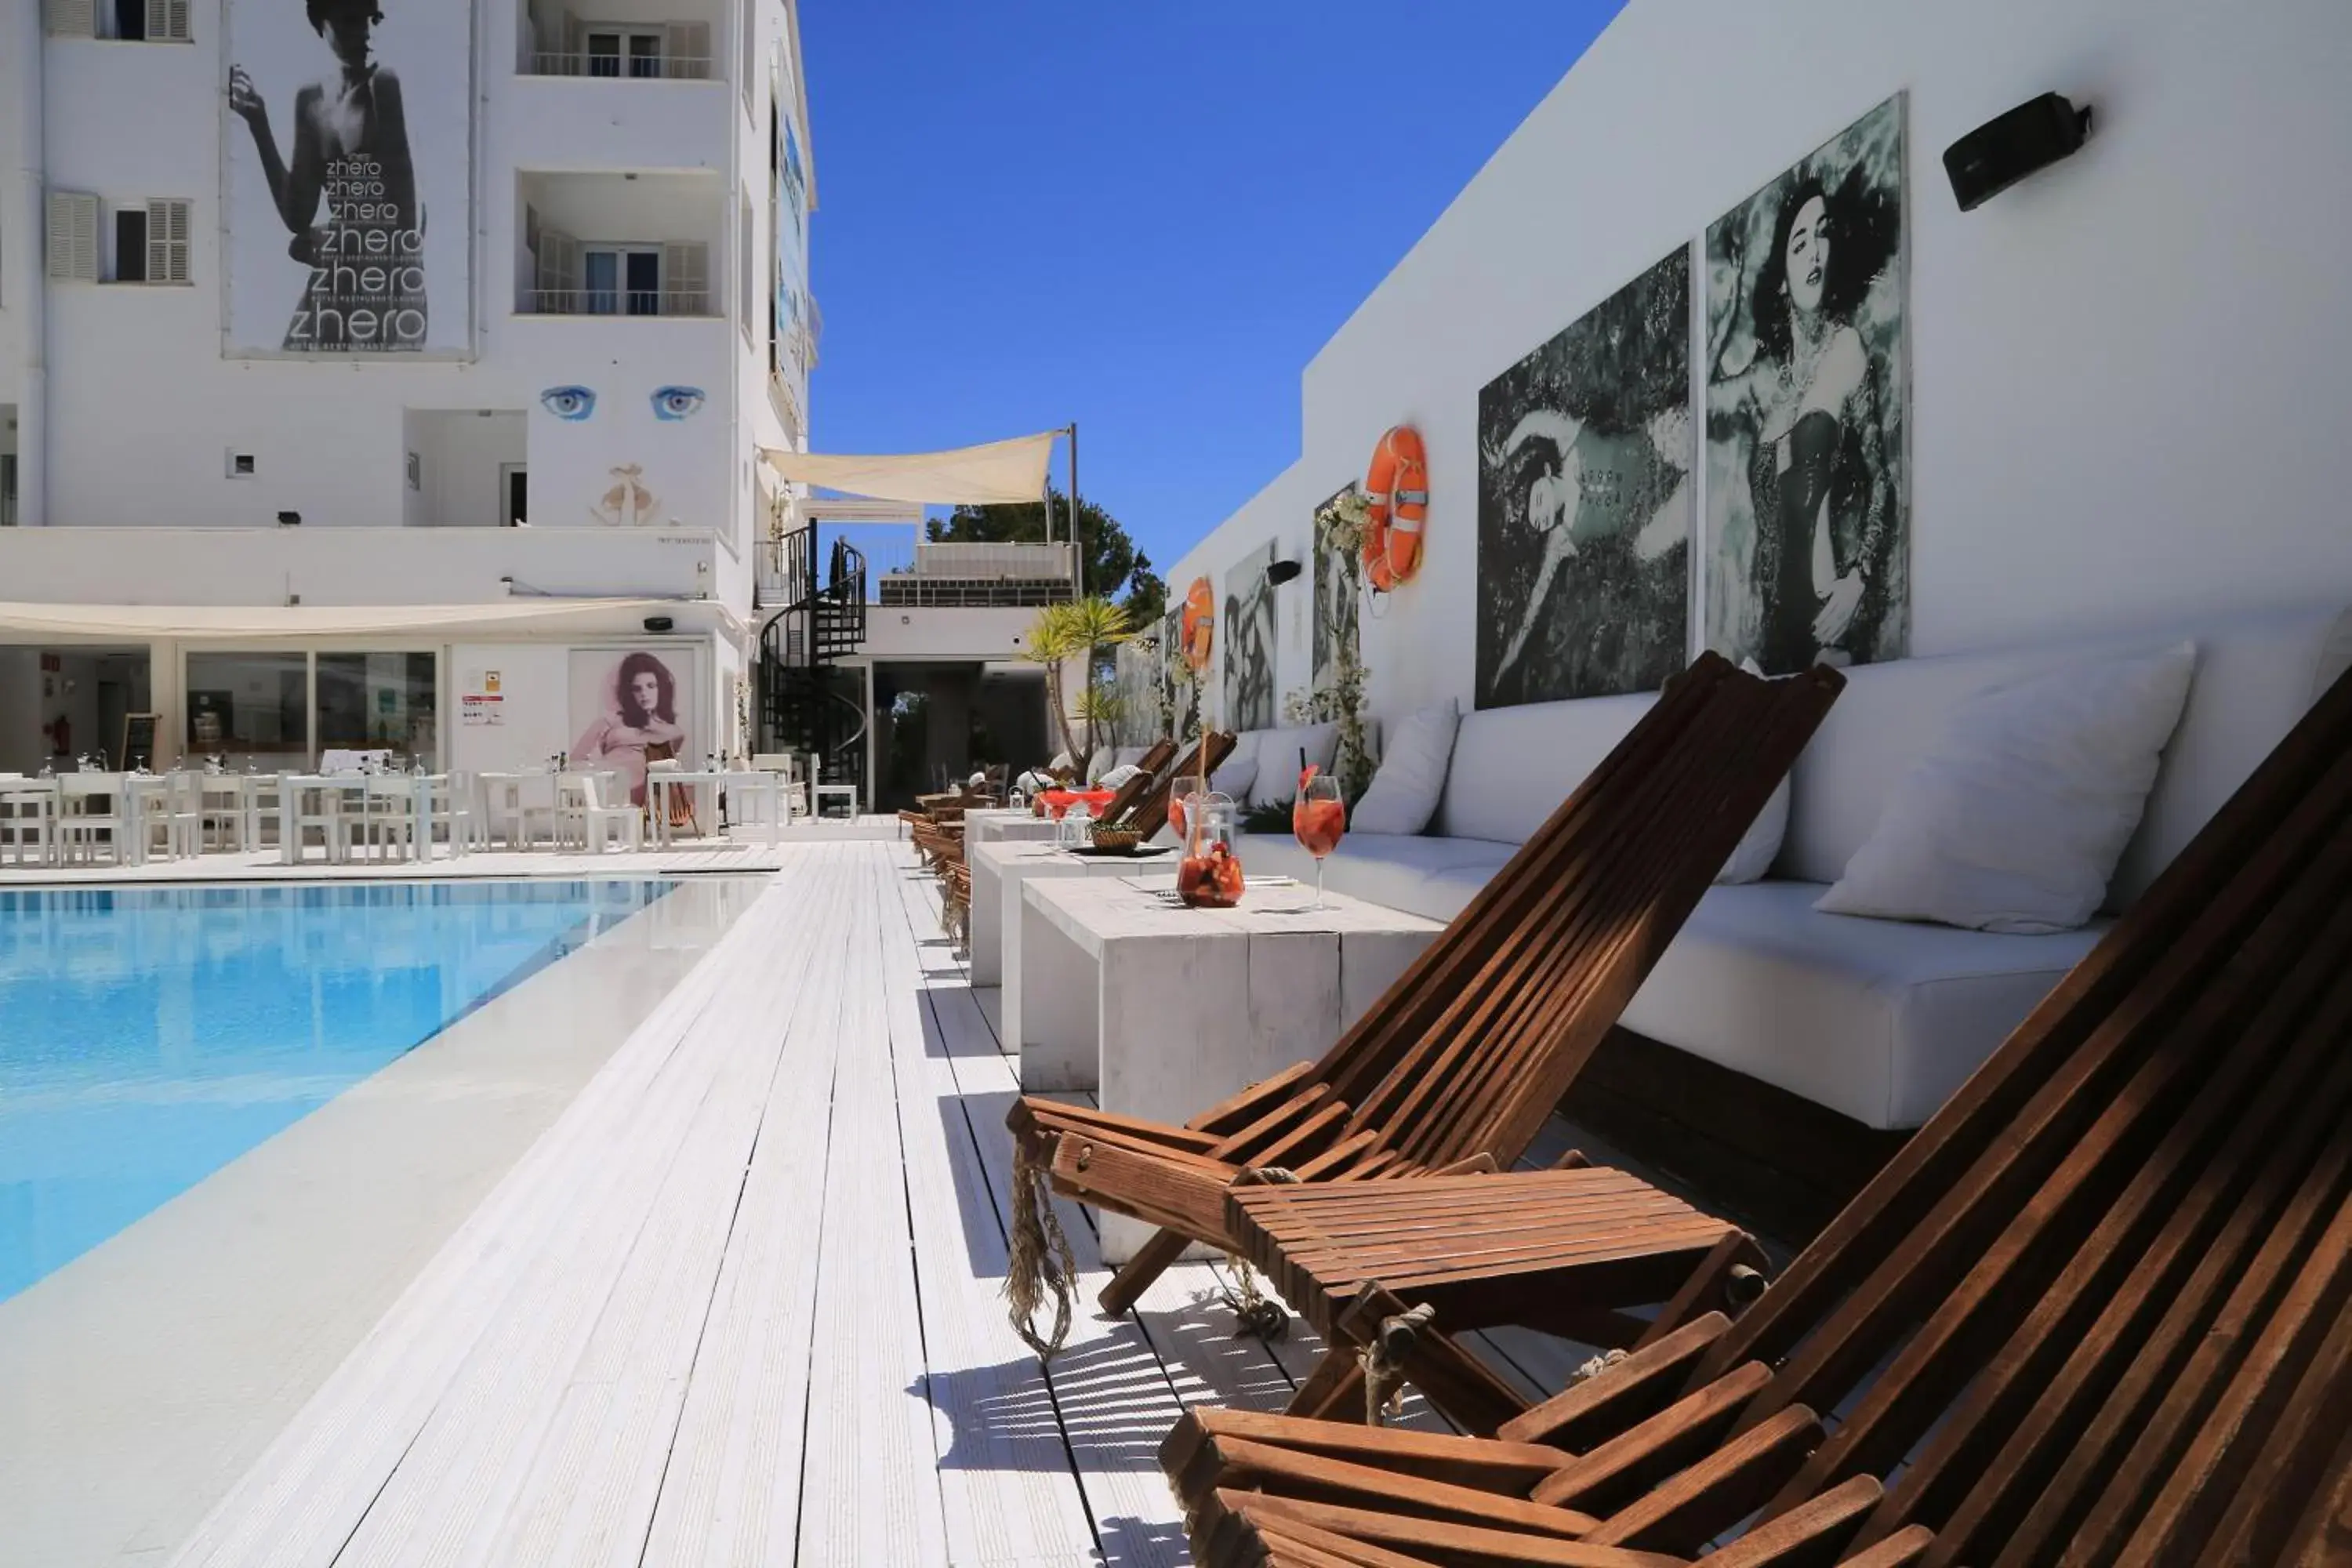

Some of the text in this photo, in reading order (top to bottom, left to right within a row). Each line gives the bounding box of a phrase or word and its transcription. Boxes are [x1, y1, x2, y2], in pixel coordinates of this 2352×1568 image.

[326, 158, 382, 176] zhero
[328, 179, 385, 197] zhero
[332, 201, 398, 220] zhero
[321, 224, 423, 253] zhero
[311, 260, 425, 293] zhero
[290, 301, 426, 340] zhero
